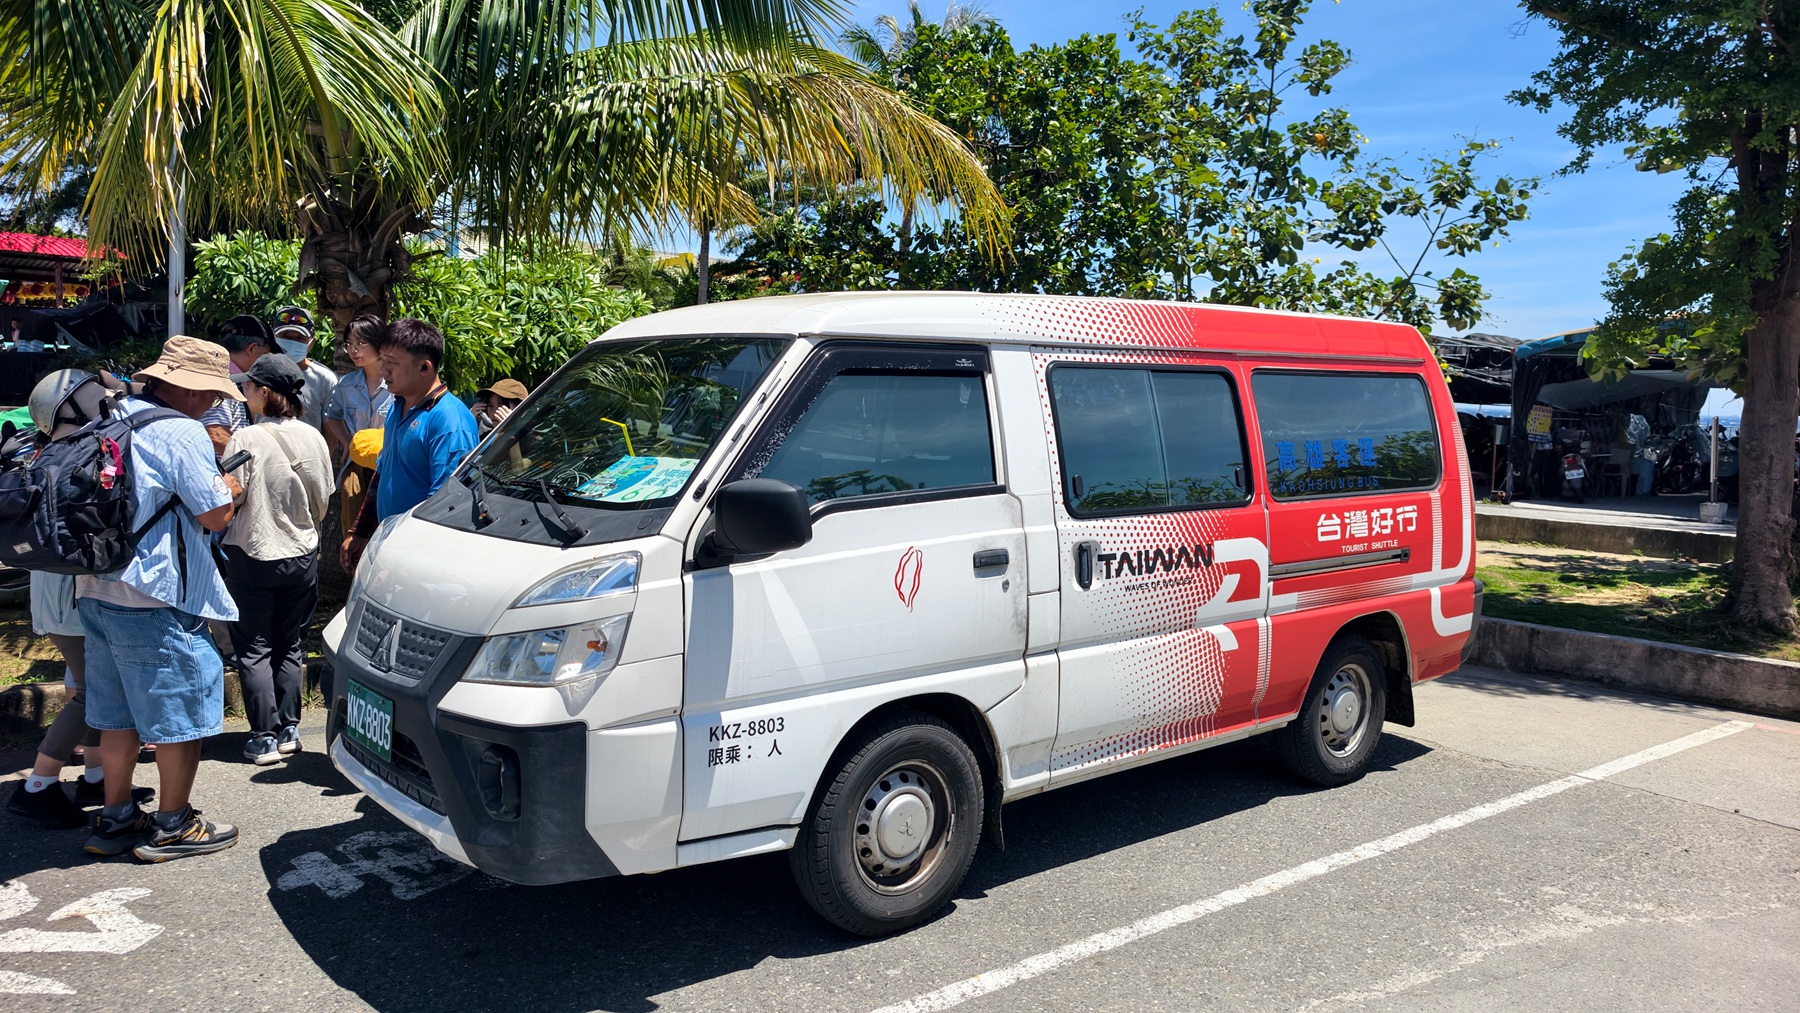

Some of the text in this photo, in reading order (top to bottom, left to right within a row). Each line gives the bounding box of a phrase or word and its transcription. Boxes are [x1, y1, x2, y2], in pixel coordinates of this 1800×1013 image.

[1275, 438, 1377, 471] 高雄客運
[1280, 475, 1379, 492] KAOHSIUNG BUS
[1317, 505, 1418, 542] 台灣好行
[1341, 539, 1398, 553] TOURIST SHUTTLE
[1097, 543, 1212, 580] TAIWAN
[1124, 578, 1193, 593] WAVES OF WONDER
[347, 692, 391, 751] KKZ-8803
[709, 716, 785, 743] KKZ-8803
[767, 738, 782, 758] 人
